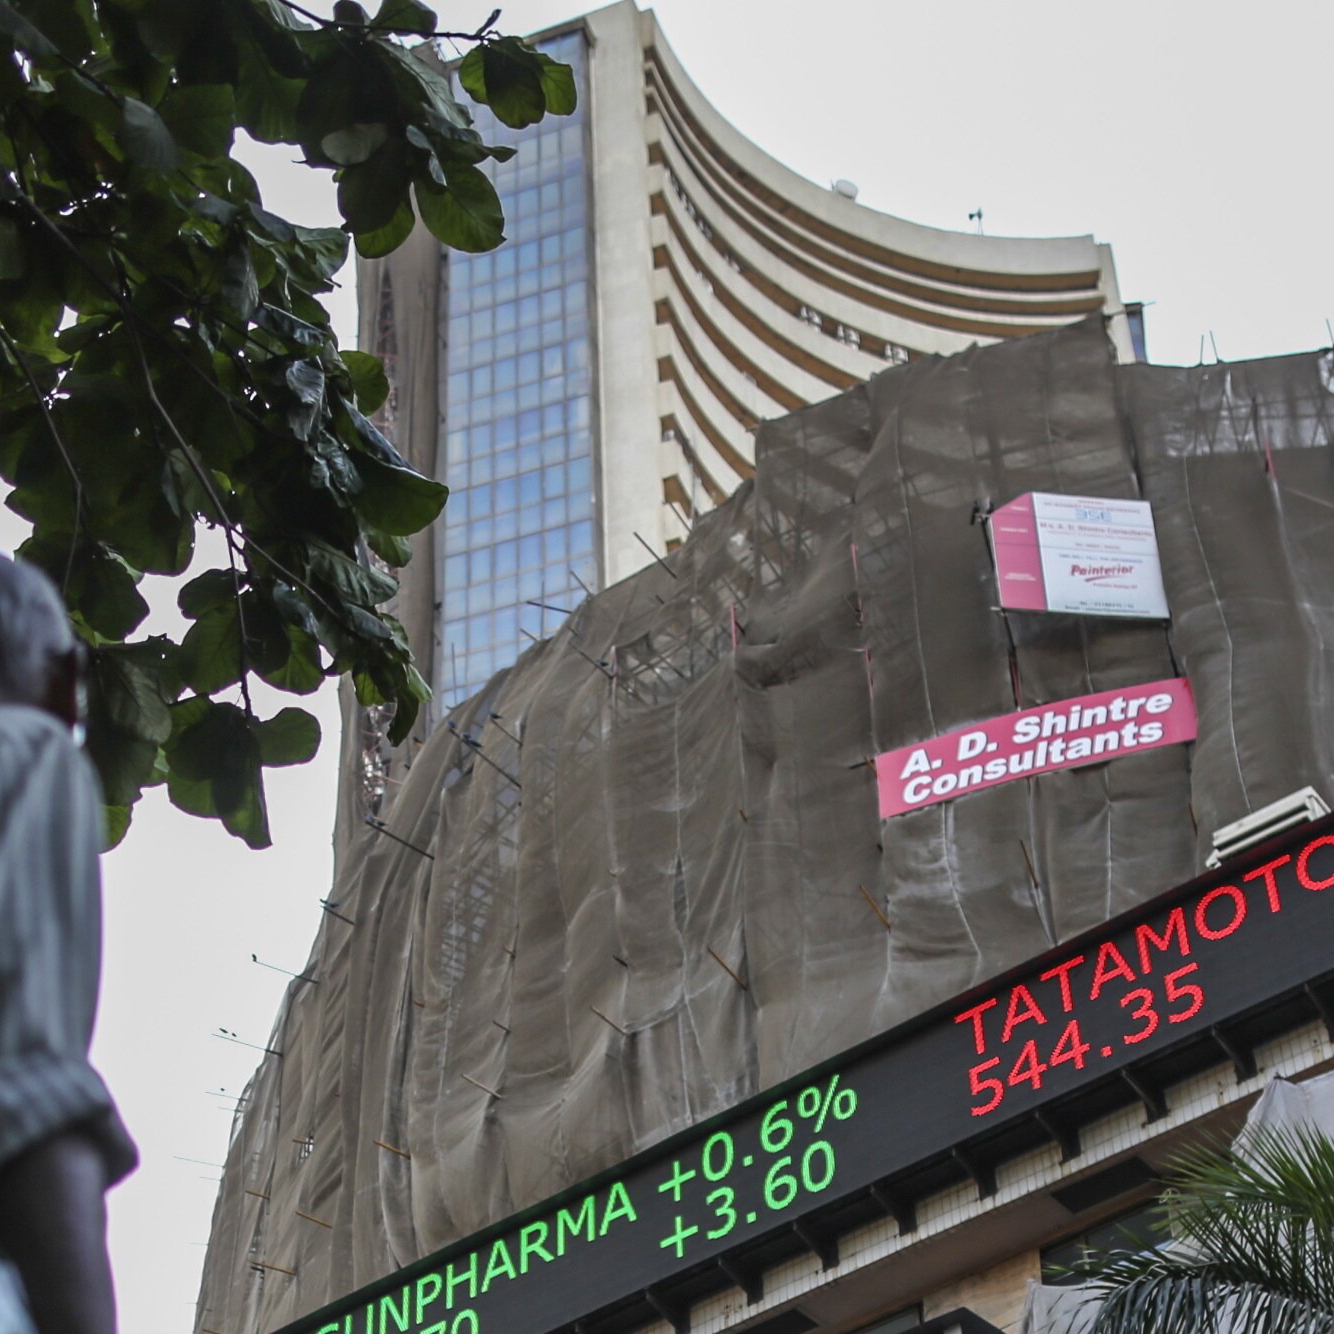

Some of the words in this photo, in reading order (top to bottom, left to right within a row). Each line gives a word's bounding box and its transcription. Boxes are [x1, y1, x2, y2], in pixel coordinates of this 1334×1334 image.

[900, 749, 942, 780] A.
[957, 731, 998, 761] D.
[1012, 692, 1173, 745] Shintre
[903, 720, 1164, 805] Consultants
[970, 962, 1206, 1117] 544.35
[658, 1074, 858, 1203] +0.6%
[661, 1140, 836, 1260] +3.60
